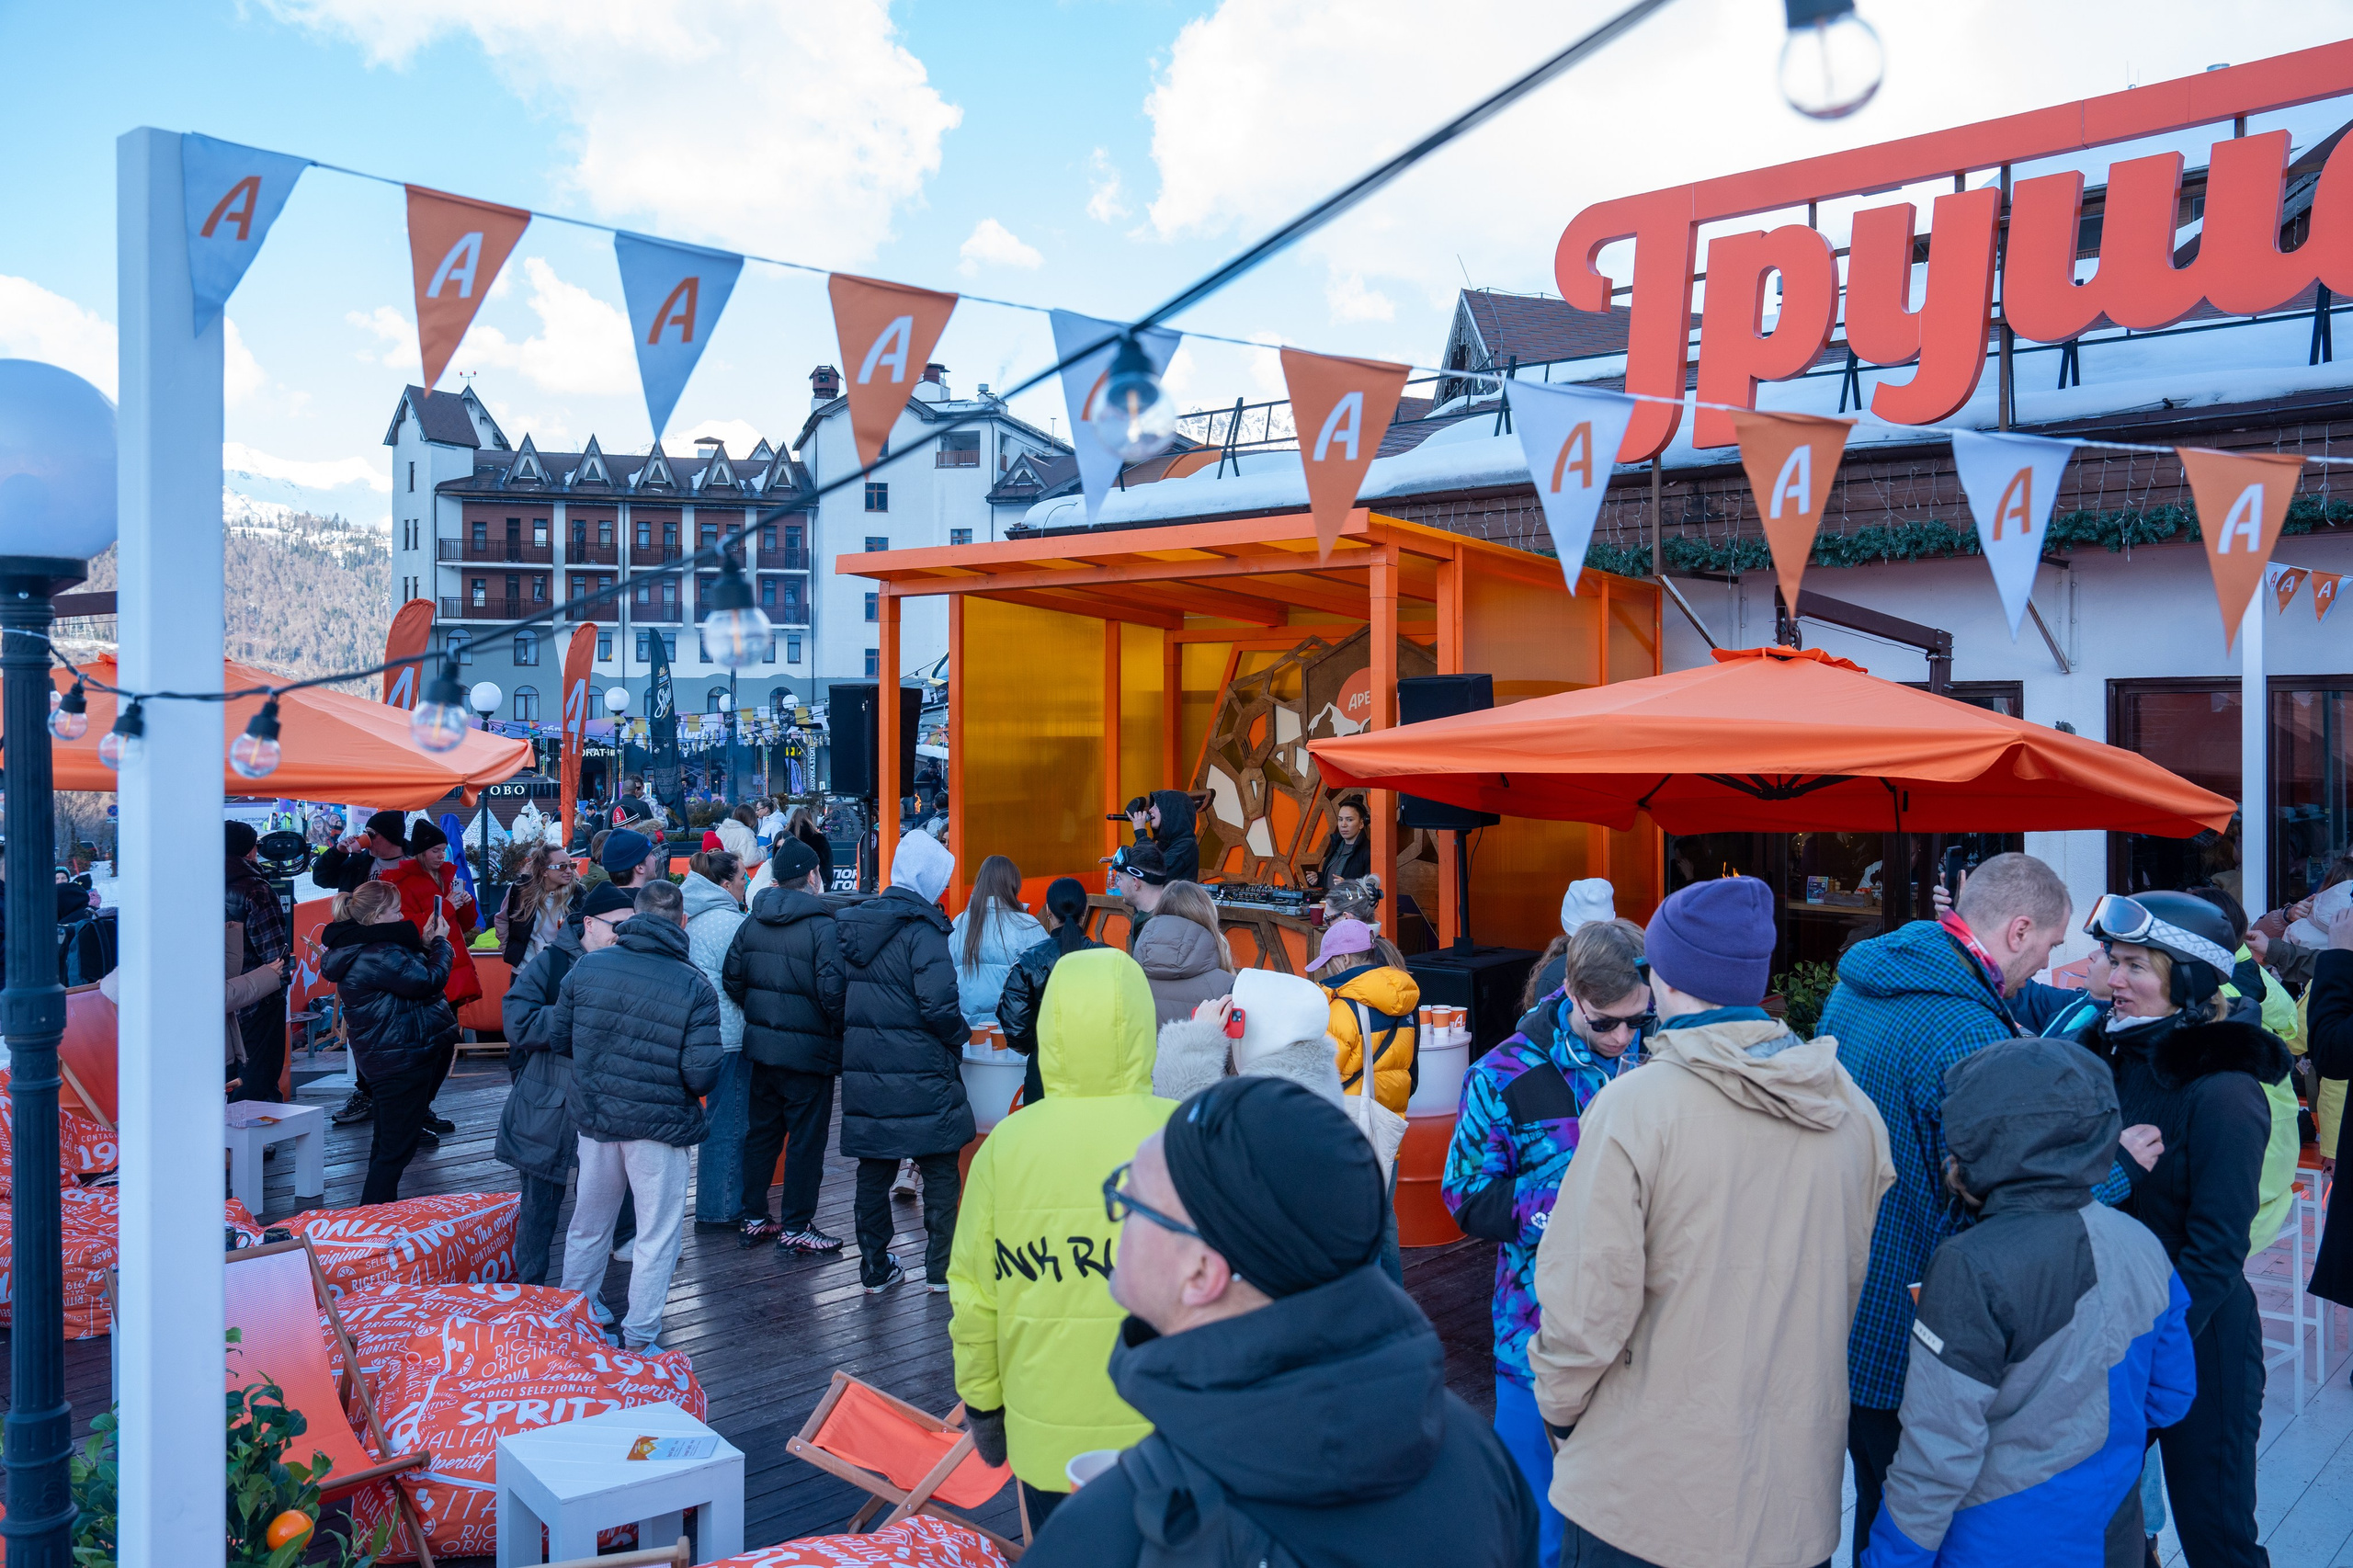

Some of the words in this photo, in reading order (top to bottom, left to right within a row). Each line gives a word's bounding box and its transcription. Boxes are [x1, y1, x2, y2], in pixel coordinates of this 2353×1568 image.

[199, 176, 262, 240] A
[426, 232, 483, 298] A
[647, 278, 699, 345] A
[858, 315, 913, 384] A
[1313, 392, 1363, 460] A
[1551, 421, 1593, 494] A
[1769, 444, 1811, 518] A
[1993, 465, 2033, 540] A
[2217, 483, 2263, 553] A
[2279, 575, 2295, 592] A
[2317, 580, 2332, 597] A
[470, 1388, 514, 1399] RADICI
[518, 1383, 597, 1397] SELEZIONATE
